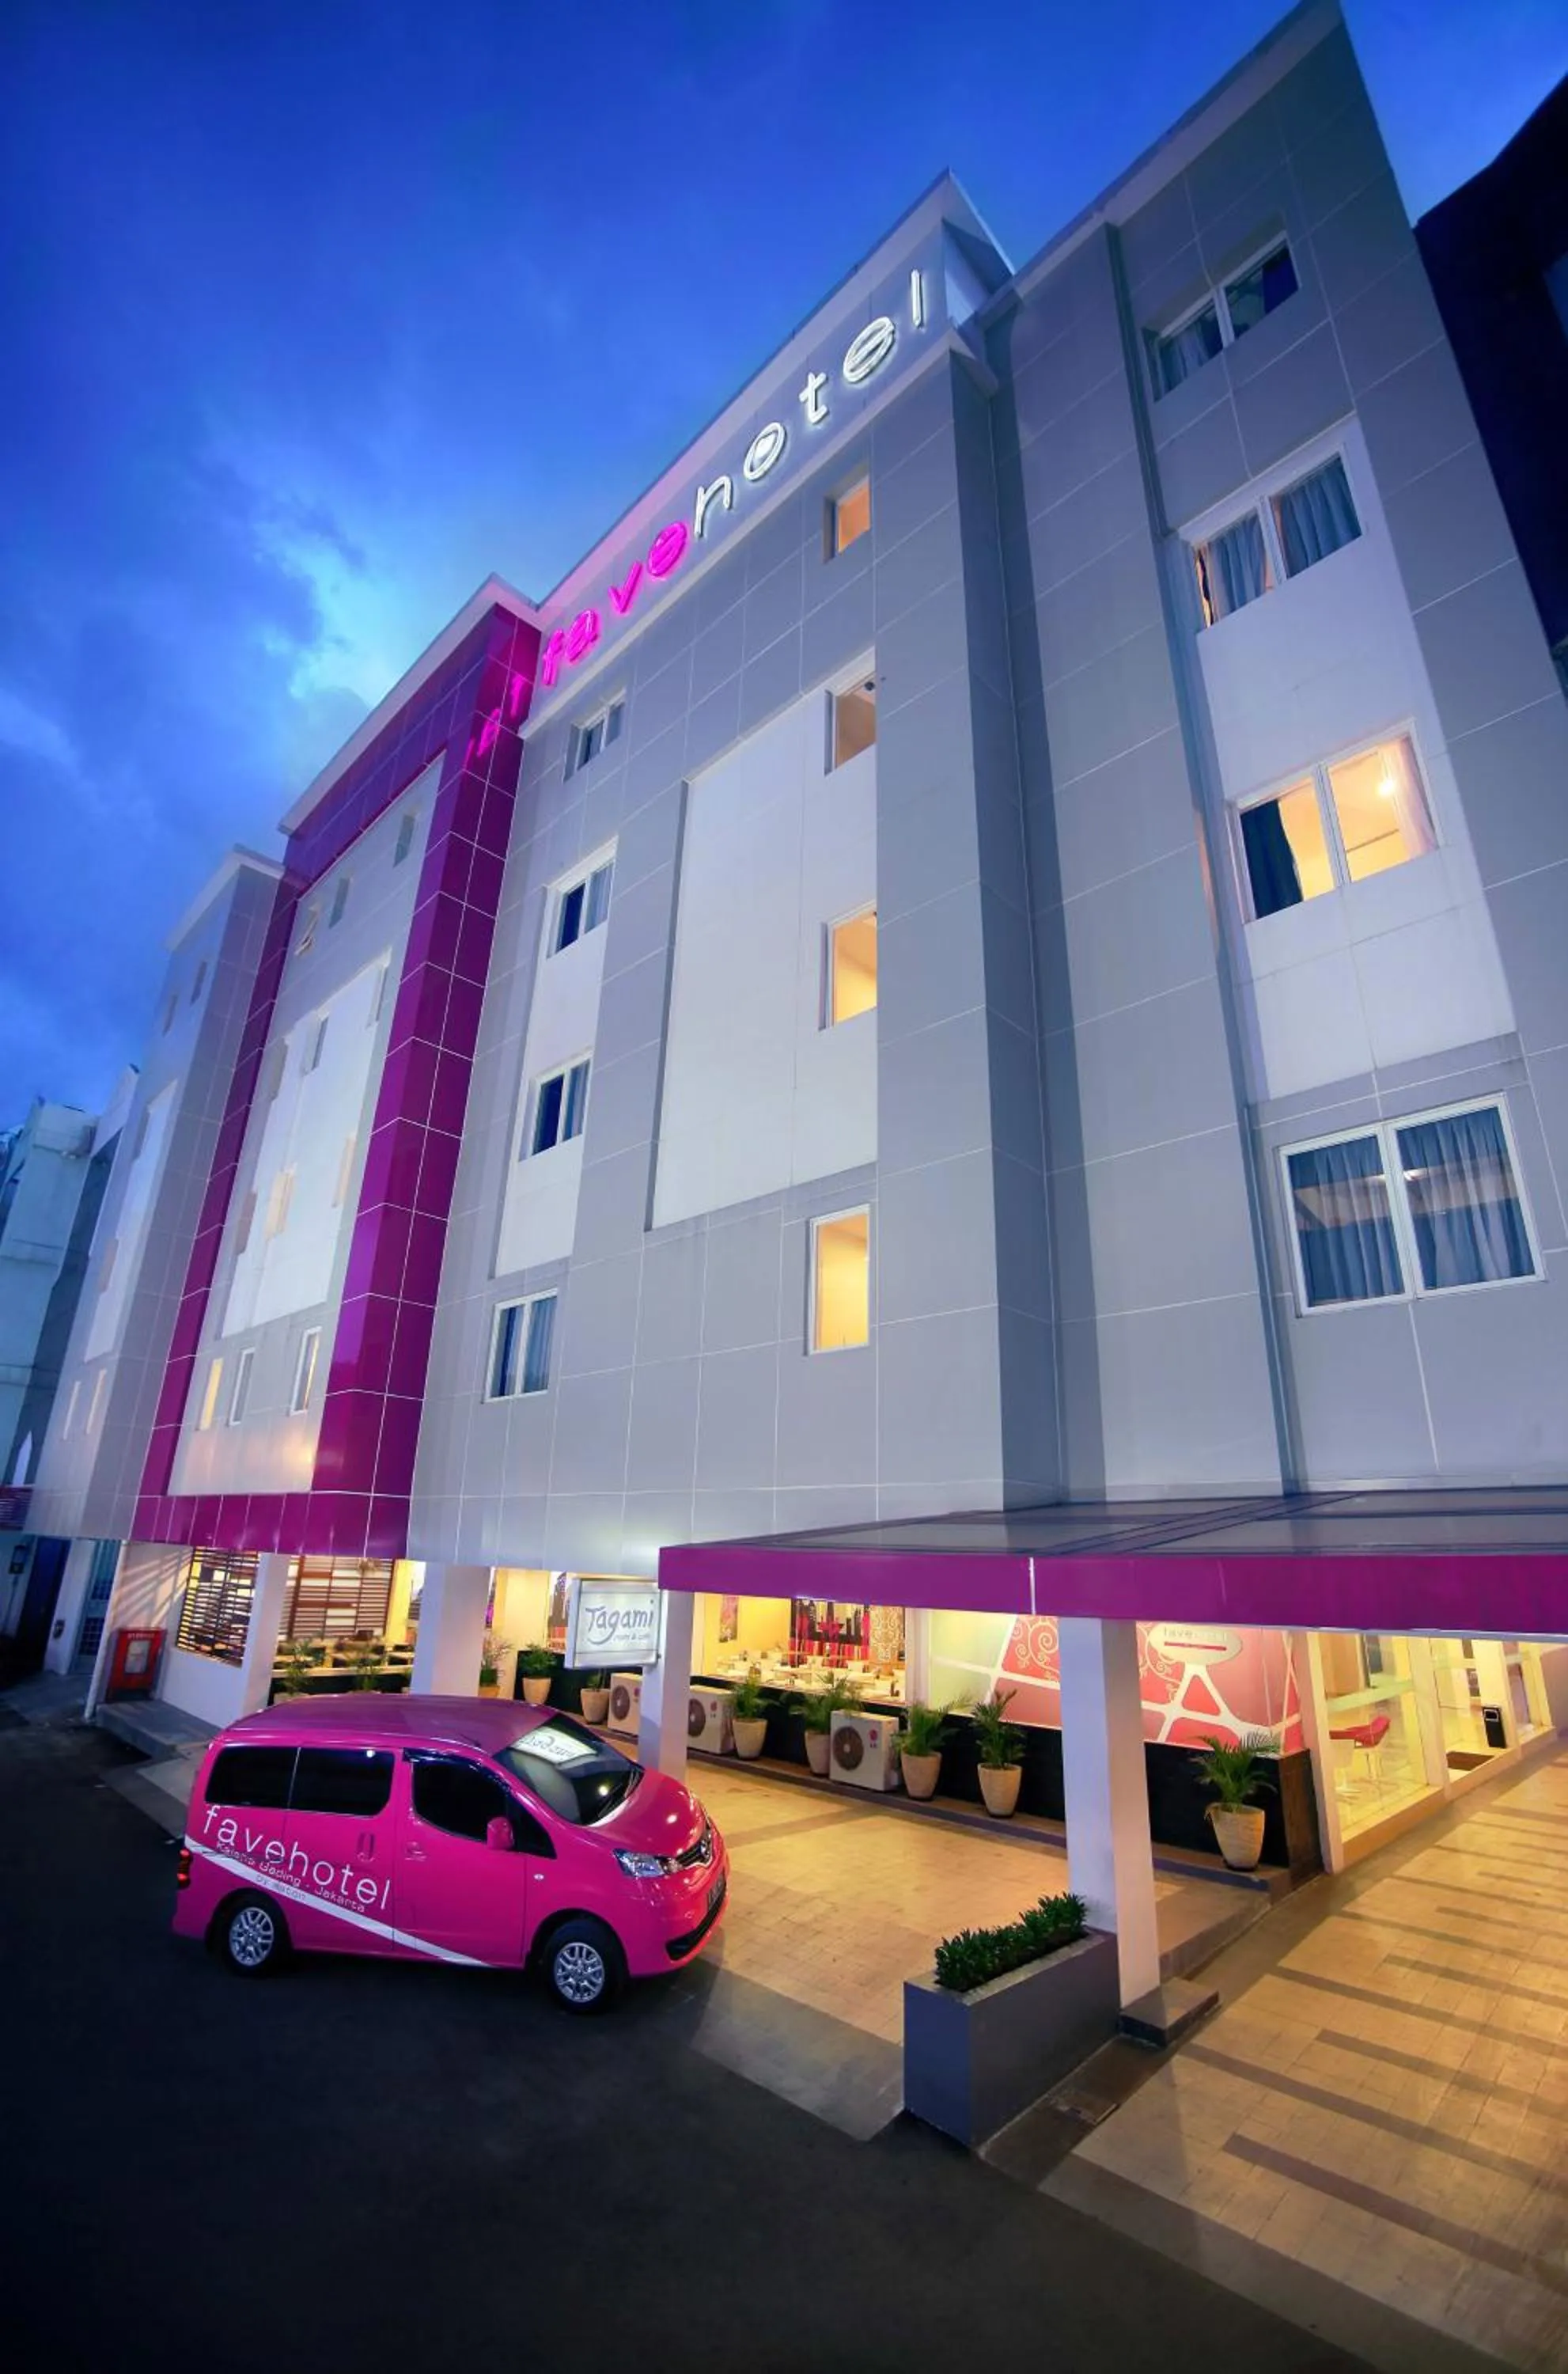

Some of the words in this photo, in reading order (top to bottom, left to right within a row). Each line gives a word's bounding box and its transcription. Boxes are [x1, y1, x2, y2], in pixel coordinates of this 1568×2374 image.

[543, 269, 924, 686] favehotel
[585, 1598, 654, 1645] Tagami
[203, 1805, 390, 1909] favehotel
[259, 1860, 301, 1887] Gading
[314, 1886, 365, 1913] Jakarta
